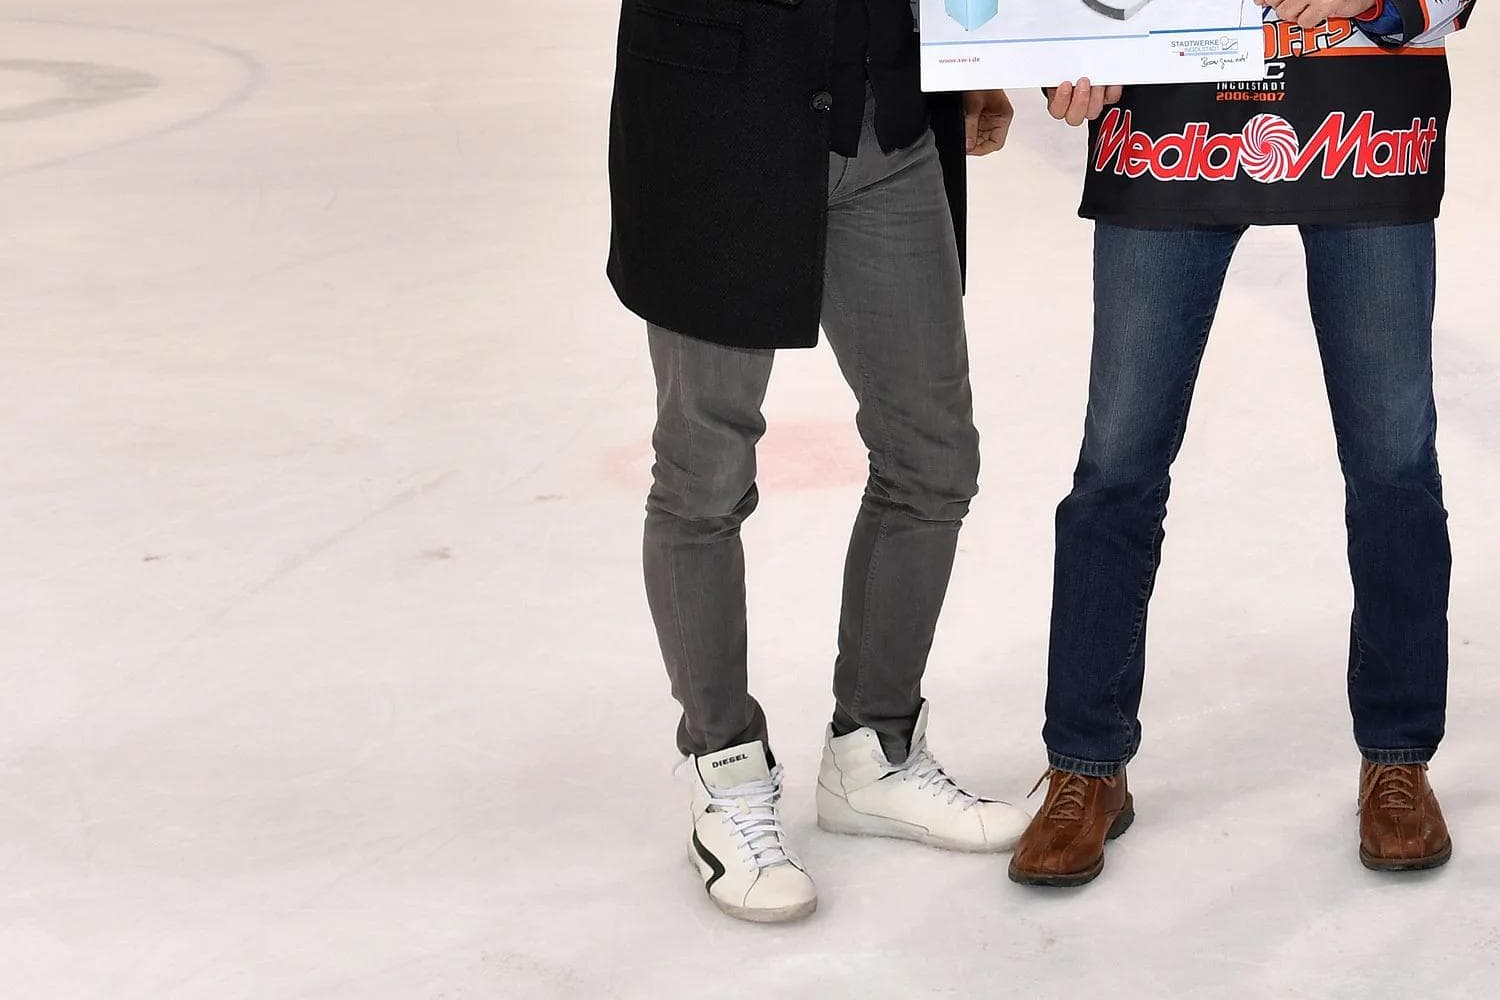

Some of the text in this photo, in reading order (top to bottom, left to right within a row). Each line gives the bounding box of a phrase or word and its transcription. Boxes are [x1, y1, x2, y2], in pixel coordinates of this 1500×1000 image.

[1170, 39, 1220, 49] STADTWERKE
[1216, 91, 1286, 102] 2006-2007
[1095, 108, 1438, 180] Media Markt
[711, 752, 749, 769] DIESEL
